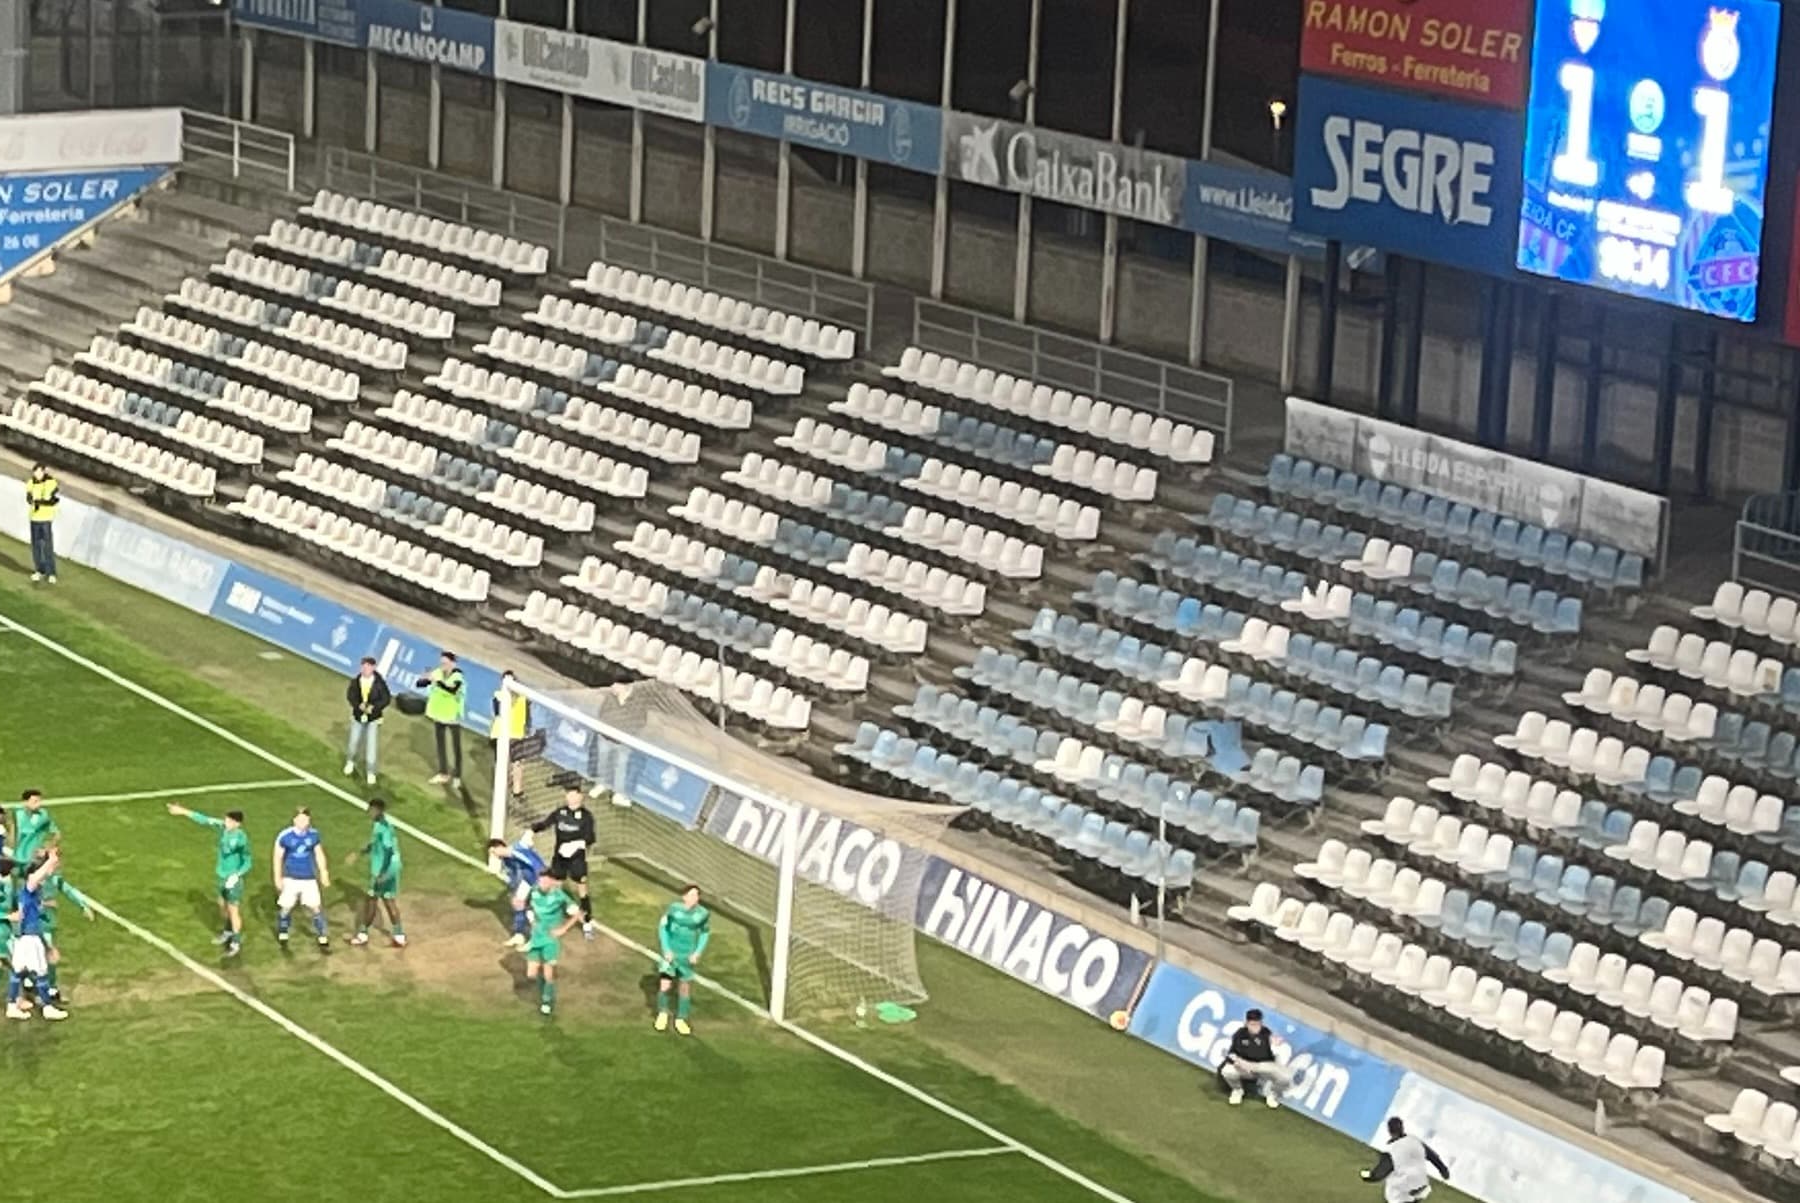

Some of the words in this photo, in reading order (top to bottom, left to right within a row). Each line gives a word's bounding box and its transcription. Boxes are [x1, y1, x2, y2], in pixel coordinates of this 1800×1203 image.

[368, 24, 486, 71] MECANOCAMP
[1306, 0, 1410, 43] RAMON
[1420, 19, 1522, 63] SOLER
[1331, 43, 1388, 75] Ferros
[753, 78, 806, 110] RECS
[810, 90, 885, 127] GARCIA
[1553, 63, 1600, 187] 1
[1007, 131, 1173, 222] CaixaBank
[1311, 115, 1495, 226] SEGRE
[1685, 87, 1735, 215] 1
[23, 179, 120, 203] SOLER
